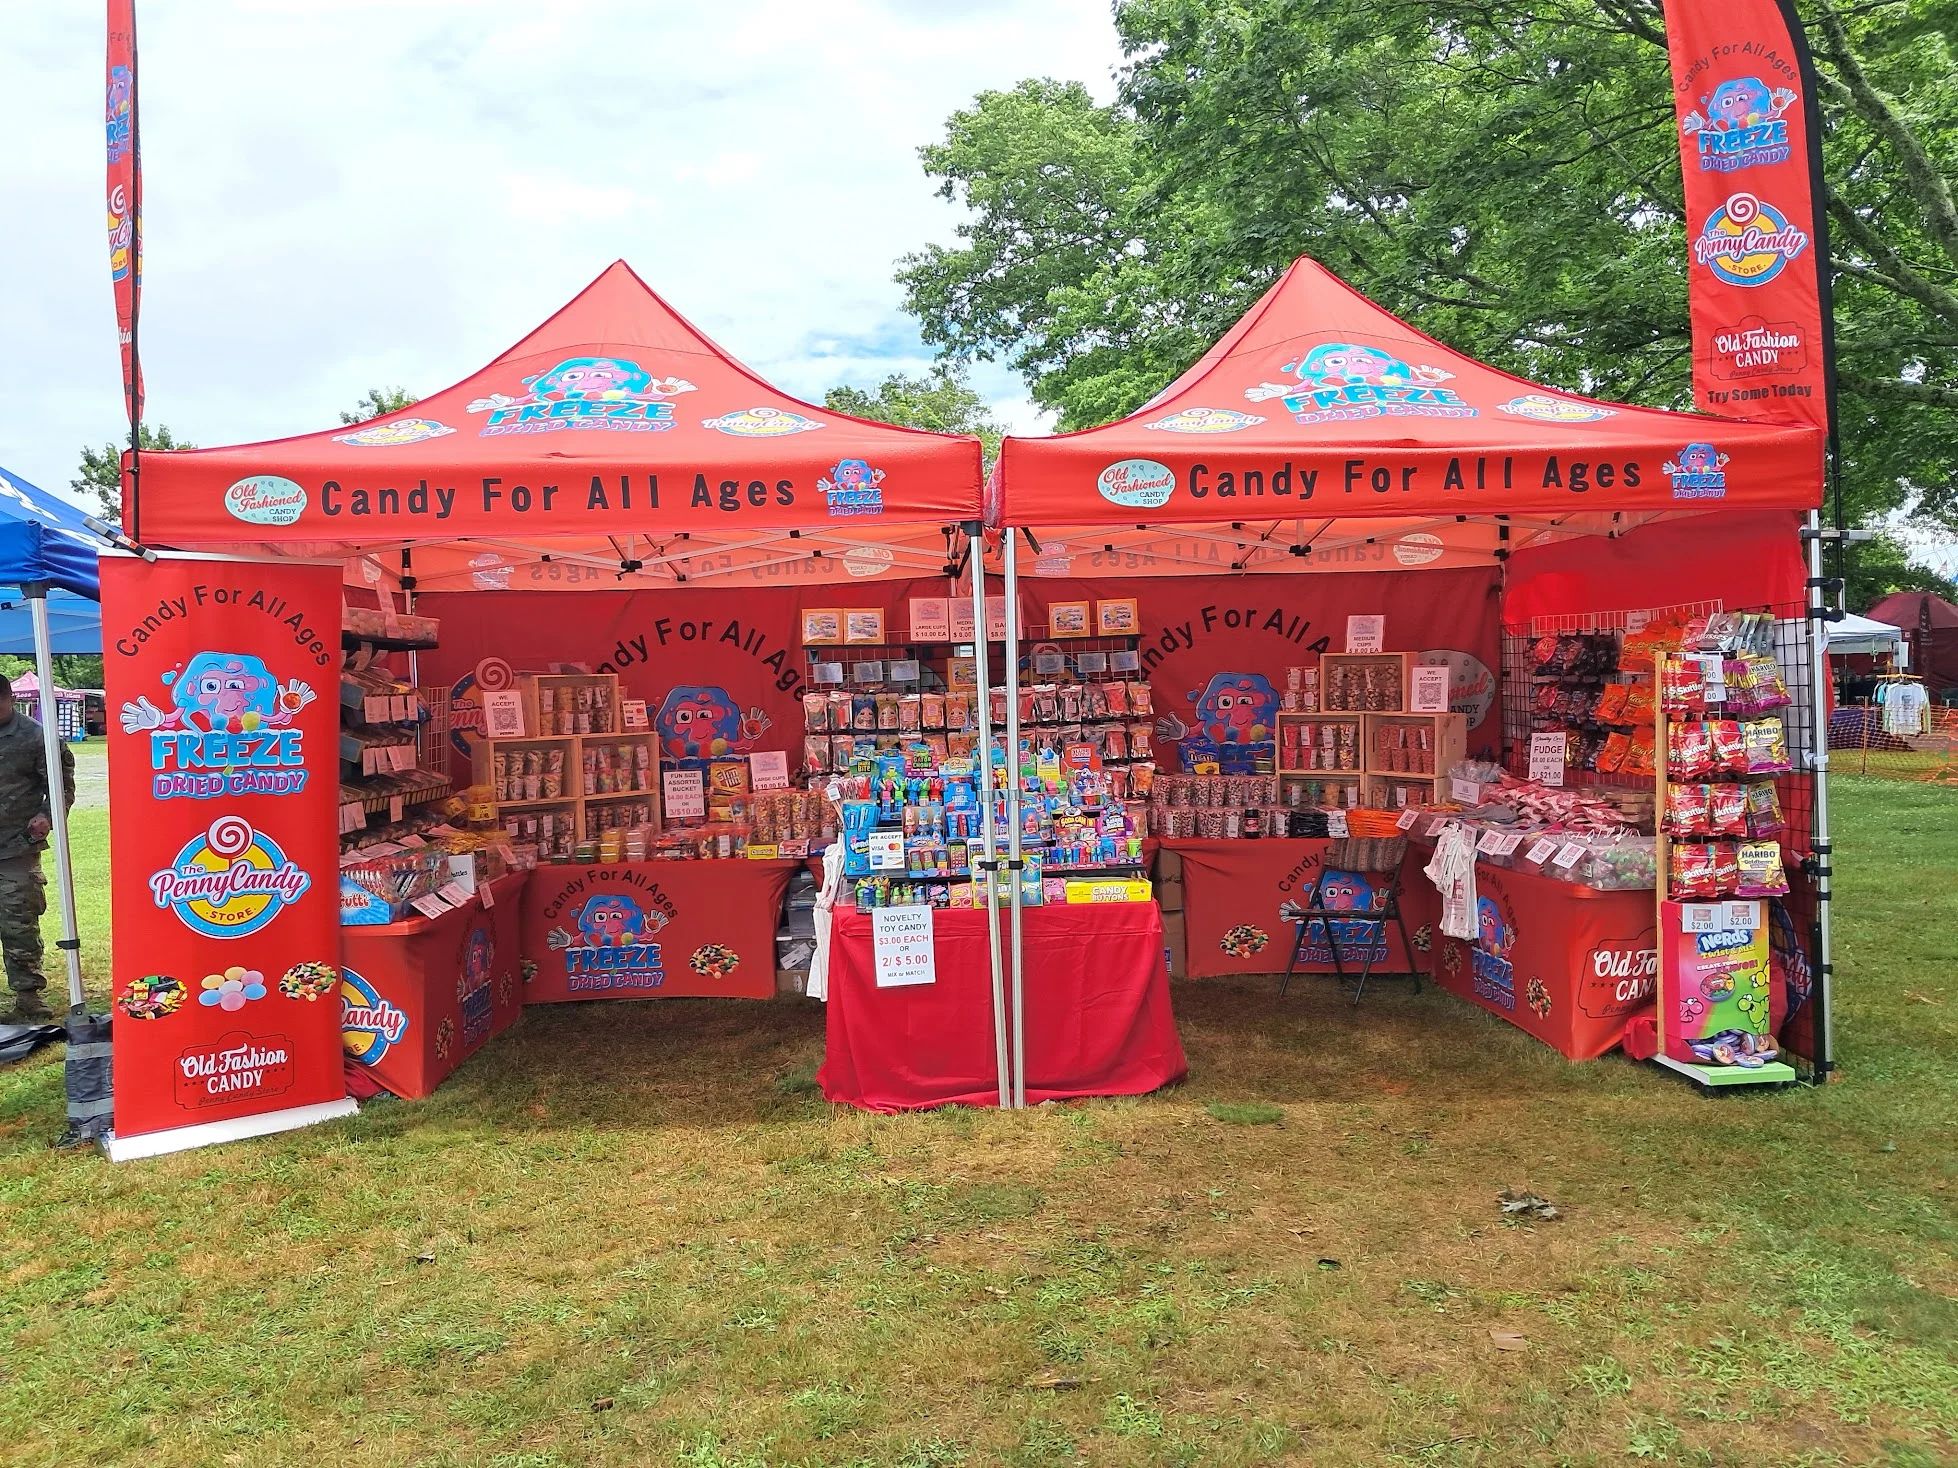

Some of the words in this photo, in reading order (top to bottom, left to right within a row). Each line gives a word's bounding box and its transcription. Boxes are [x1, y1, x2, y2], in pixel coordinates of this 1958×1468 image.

[1679, 56, 1711, 93] Candy
[1711, 43, 1738, 60] For
[1742, 41, 1766, 57] All
[1765, 51, 1796, 81] Ages
[1698, 119, 1789, 155] FREEZE
[1702, 155, 1739, 171] DRIED
[1742, 147, 1790, 166] CANDY
[1709, 229, 1727, 237] The
[1731, 264, 1765, 275] STORE
[1715, 334, 1743, 353] Old
[1742, 326, 1800, 349] Fashion
[1735, 350, 1779, 368] CANDY
[1283, 385, 1467, 413] FREEZE
[1707, 390, 1729, 404] Try
[1732, 387, 1769, 401] Some
[1771, 383, 1812, 398] Today
[489, 400, 675, 425] FREEZE
[1296, 406, 1379, 426] DRIED
[1381, 403, 1480, 417] CANDY
[483, 417, 567, 437] DRIED
[570, 418, 677, 434] CANDY
[1102, 467, 1128, 484] Old
[1189, 462, 1319, 500] Candy
[1344, 459, 1418, 492] For
[1443, 457, 1512, 490] All
[1541, 455, 1641, 492] Ages
[1672, 472, 1726, 488] FREEZE
[230, 483, 258, 501] Old
[1110, 474, 1173, 496] Fashioned
[238, 490, 302, 513] Fashioned
[321, 479, 456, 519] Candy
[482, 478, 558, 513] For
[587, 474, 659, 510] All
[690, 473, 795, 511] Ages
[827, 488, 882, 505] FREEZE
[1139, 491, 1166, 499] CANDY
[272, 515, 294, 523] SHOP
[116, 594, 187, 656] Candy
[193, 585, 241, 606] For
[247, 589, 287, 618] All
[284, 612, 332, 667] Ages
[1201, 605, 1257, 632] For
[1263, 608, 1311, 644] All
[655, 617, 713, 646] For
[719, 620, 766, 657] All
[1751, 663, 1777, 673] HARIBO
[453, 699, 473, 708] The
[1449, 704, 1480, 714] ANDY
[1746, 727, 1778, 737] HARIBO
[150, 729, 304, 769] FREEZE
[1534, 745, 1562, 754] FUDGE
[1682, 744, 1710, 758] Skittles
[1718, 743, 1746, 754] Skittles
[156, 773, 224, 796] DRIED
[229, 771, 306, 793] CANDY
[1531, 771, 1539, 779] 3/
[1540, 771, 1561, 779] $21.00
[1751, 789, 1773, 799] HARIBO
[669, 808, 702, 816] 3/$10.00
[1742, 850, 1776, 858] HARIBO
[182, 865, 204, 875] The
[1278, 853, 1320, 892] Candy
[1682, 867, 1713, 880] Skittles
[544, 877, 585, 920] Candy
[587, 869, 618, 884] For
[622, 869, 648, 888] All
[646, 882, 678, 919] Ages
[1092, 885, 1129, 895] CANDY
[1092, 893, 1129, 902] BUTTONS
[209, 907, 254, 922] STORE
[884, 913, 922, 922] NOVELTY
[1730, 917, 1752, 926] $2.00
[879, 925, 896, 933] TOY
[898, 923, 927, 932] CANDY
[1691, 922, 1714, 930] $2.00
[879, 936, 901, 945] $3.00
[903, 935, 929, 944] EACH
[565, 944, 663, 973] FREEZE
[882, 957, 892, 966] 2/
[895, 956, 902, 966] $
[905, 954, 928, 965] 5.00
[1594, 950, 1632, 978] Old
[1472, 946, 1514, 991] FREEZE
[569, 973, 612, 990] DRIED
[616, 971, 664, 988] CANDY
[181, 1053, 217, 1079] Old
[218, 1043, 289, 1074] Fashion
[207, 1069, 263, 1093] CANDY
